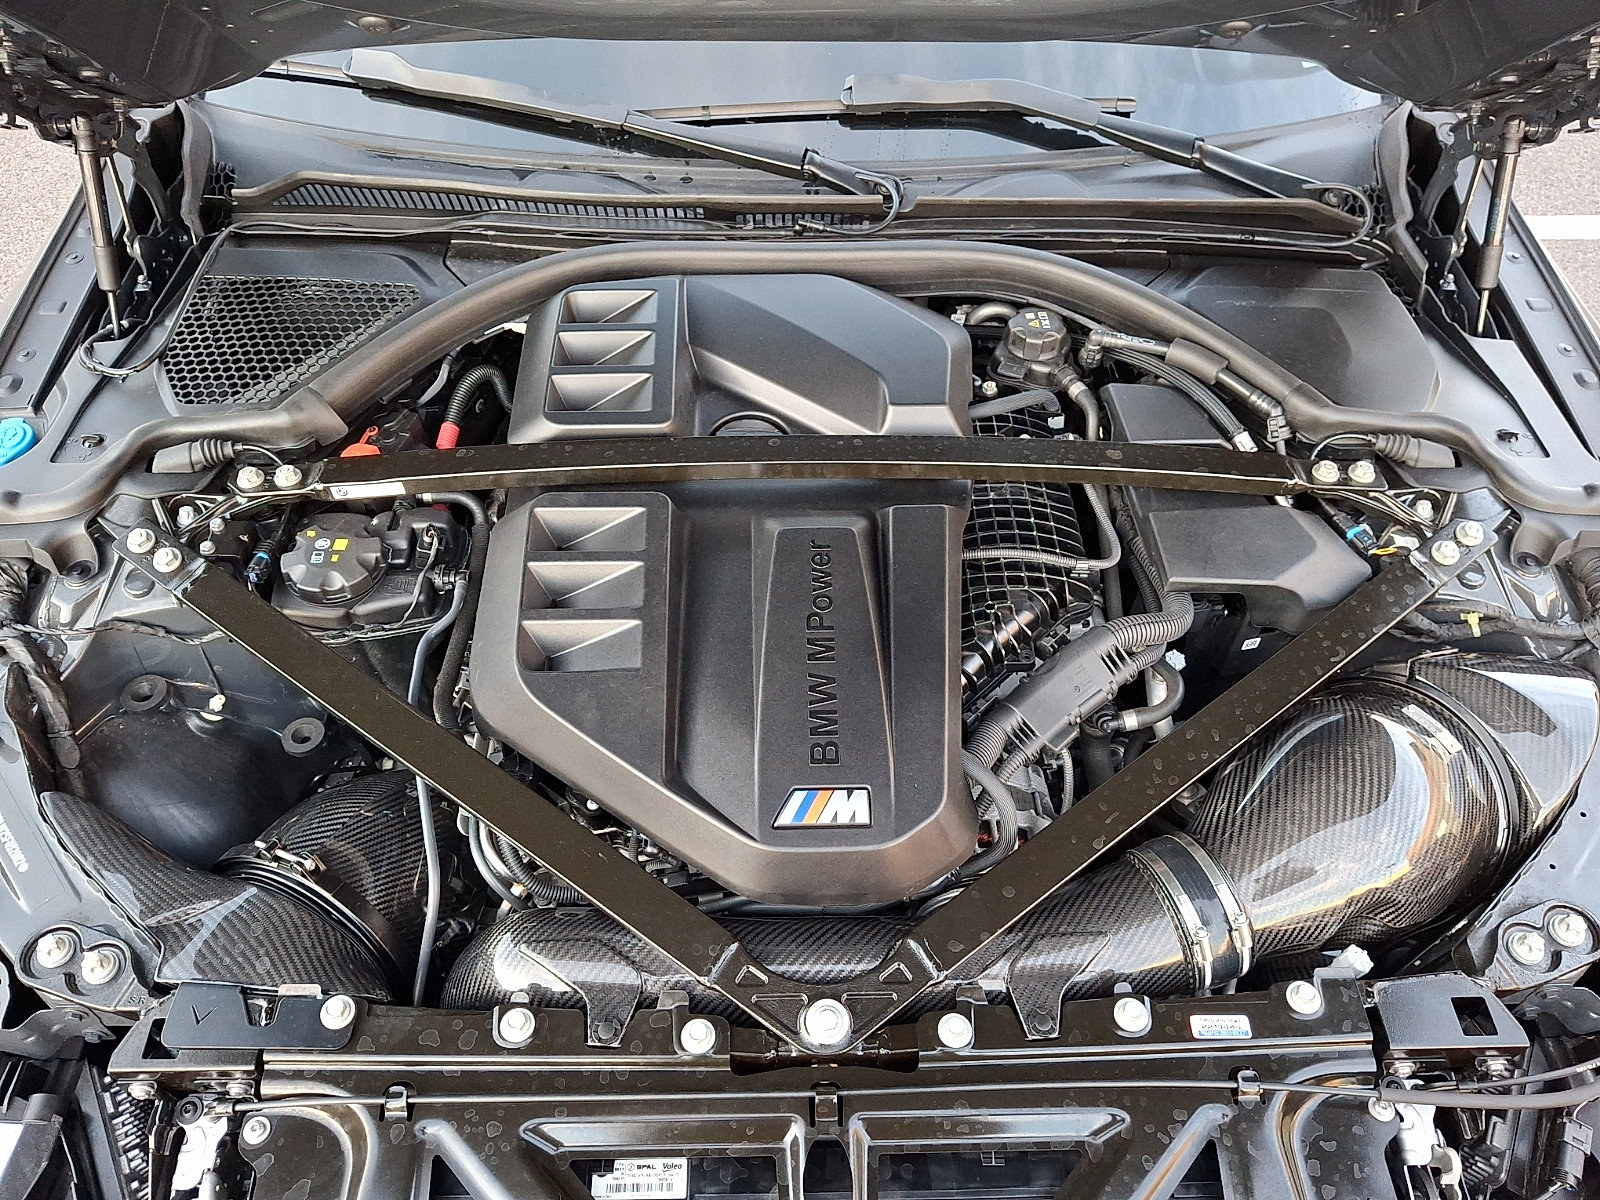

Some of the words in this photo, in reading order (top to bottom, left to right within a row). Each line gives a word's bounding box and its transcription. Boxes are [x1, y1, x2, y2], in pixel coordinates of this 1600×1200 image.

[806, 539, 836, 664] MPower
[808, 672, 841, 767] BMW
[662, 1162, 683, 1170] Valeo
